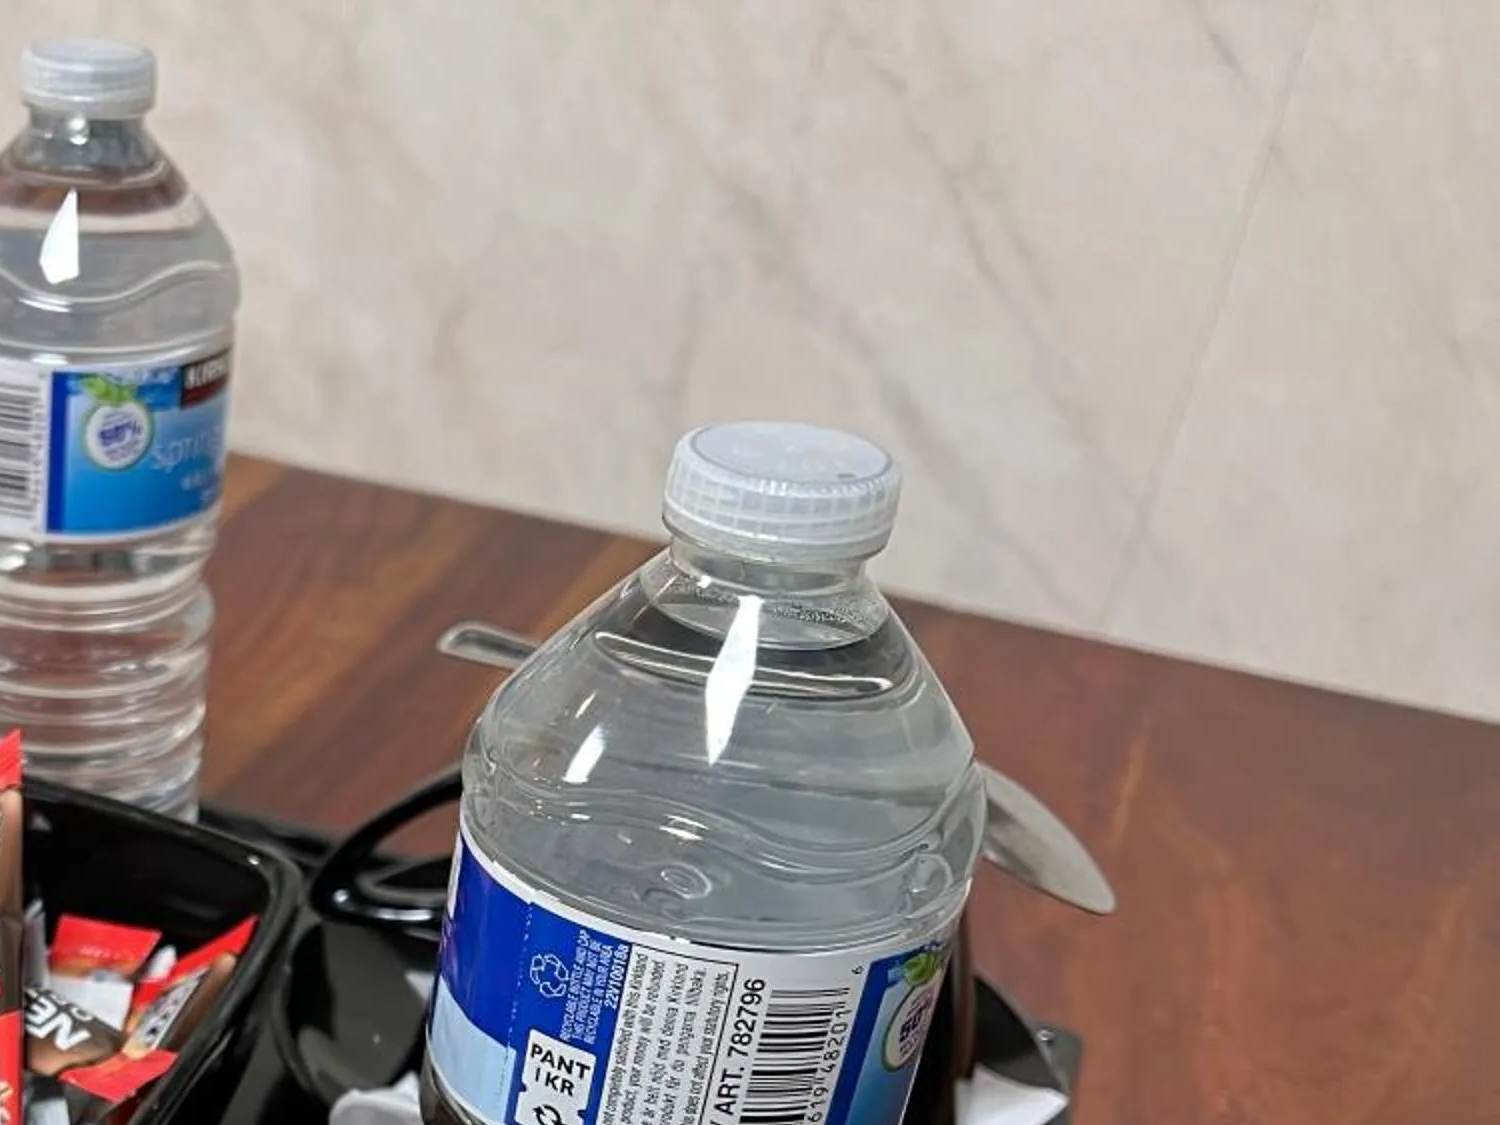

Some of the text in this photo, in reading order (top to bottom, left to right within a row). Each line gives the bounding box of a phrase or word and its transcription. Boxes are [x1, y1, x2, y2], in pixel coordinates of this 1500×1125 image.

[728, 976, 765, 1060] 782796
[821, 1009, 852, 1073] 48201
[531, 1043, 591, 1079] PANT
[545, 1071, 575, 1097] KR
[715, 1062, 744, 1116] ART.
